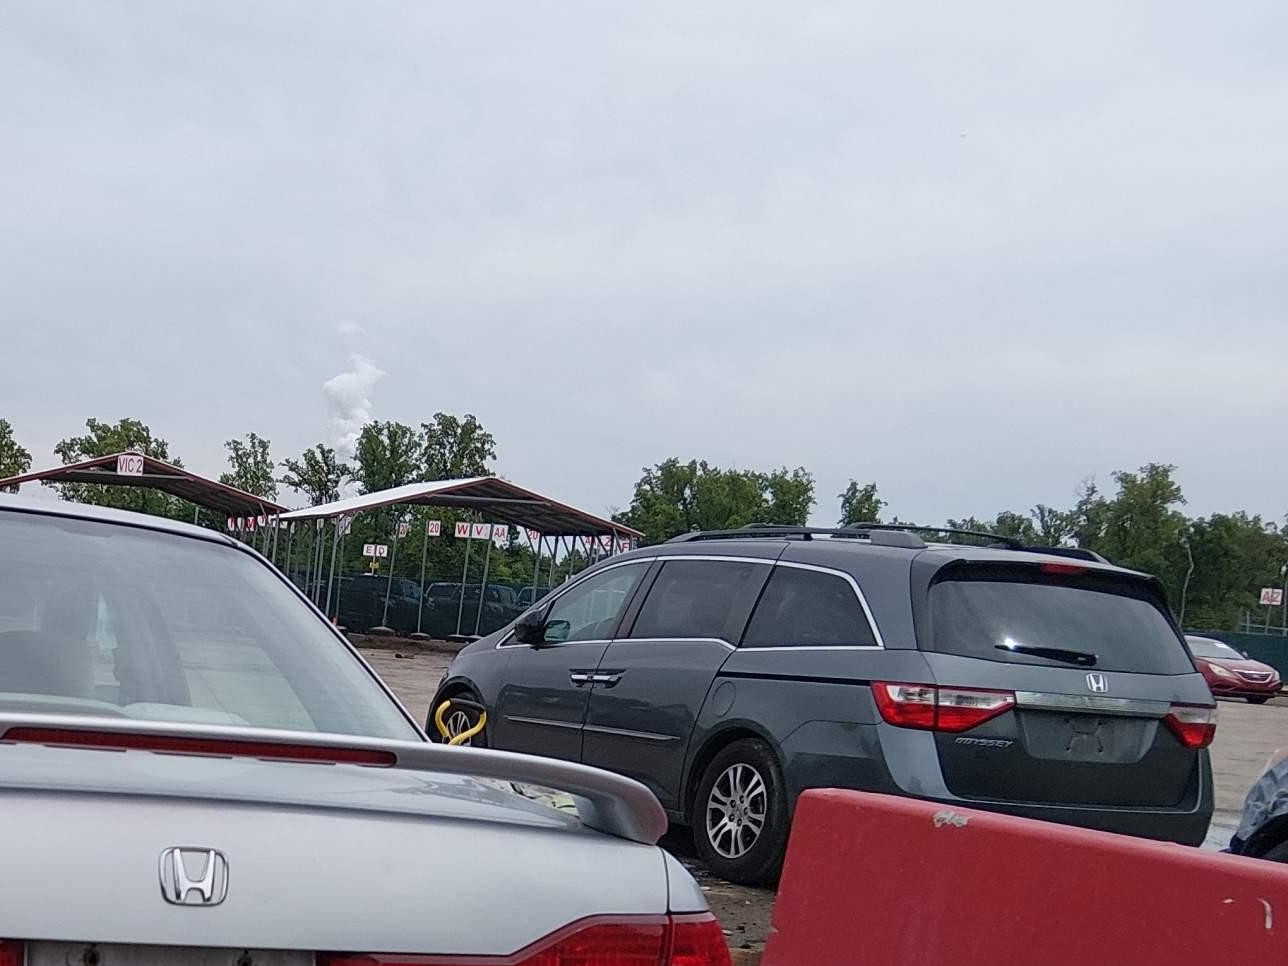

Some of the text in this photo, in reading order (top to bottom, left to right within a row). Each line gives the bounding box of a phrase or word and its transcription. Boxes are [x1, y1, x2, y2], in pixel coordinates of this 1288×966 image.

[118, 457, 143, 473] VIC 2
[429, 523, 440, 534] 20
[457, 524, 469, 535] W
[494, 527, 505, 538] AA
[365, 546, 373, 554] E
[378, 547, 385, 556] D
